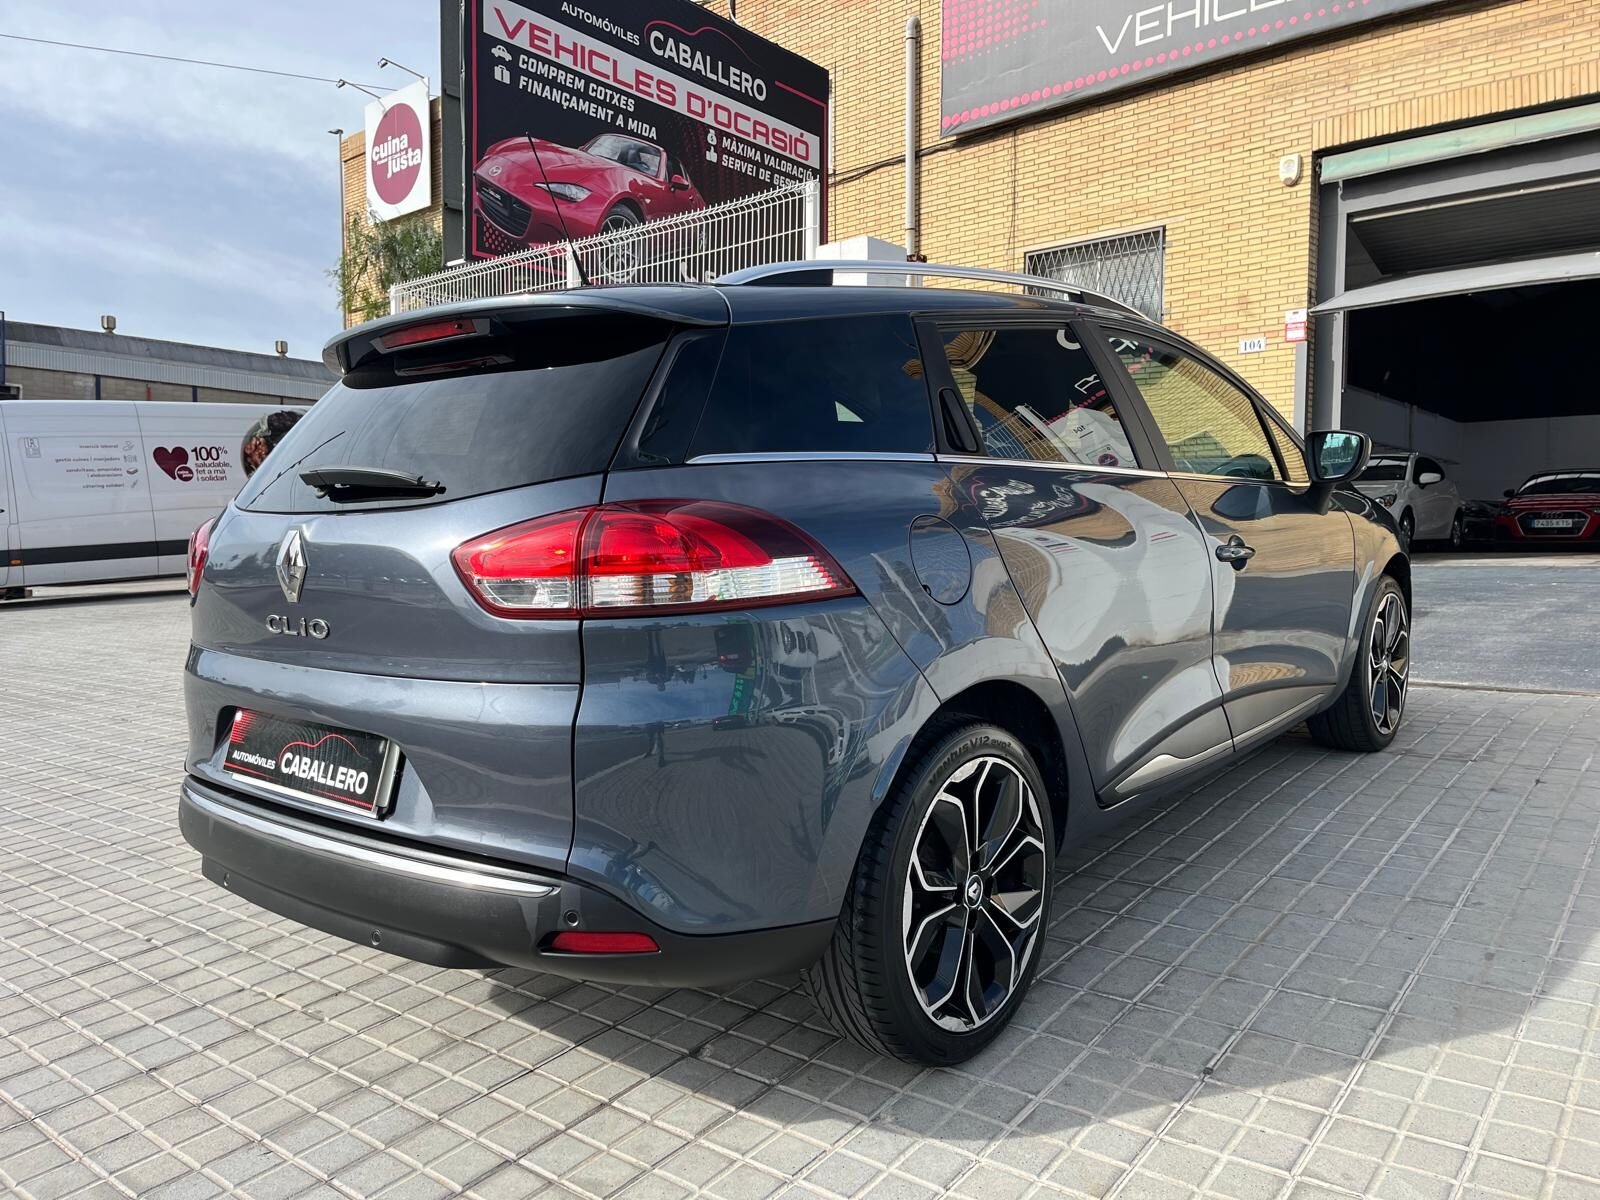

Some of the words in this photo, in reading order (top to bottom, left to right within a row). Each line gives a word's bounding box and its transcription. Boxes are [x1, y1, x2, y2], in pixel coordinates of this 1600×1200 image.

[561, 1, 641, 47] AUTOMÓVILES
[649, 30, 767, 102] CABALLERO
[494, 6, 677, 107] VEHICLES
[686, 91, 810, 162] D'OCASIÓ
[518, 53, 585, 92] COMPREM
[588, 82, 636, 112] COTXES
[518, 75, 614, 123] FINANÇAMENT
[615, 113, 625, 128] A
[627, 117, 658, 141] MIDA
[372, 133, 408, 161] cuina
[386, 147, 421, 179] justa
[721, 136, 761, 163] MÀXIMA
[764, 152, 813, 181] VALORACIÓ
[721, 154, 757, 177] SERVEI
[758, 168, 772, 183] DE
[191, 446, 228, 461] 100%
[265, 614, 330, 640] CLIO
[232, 749, 276, 770] AUTOMÓVILES
[280, 752, 369, 795] CABALLERO
